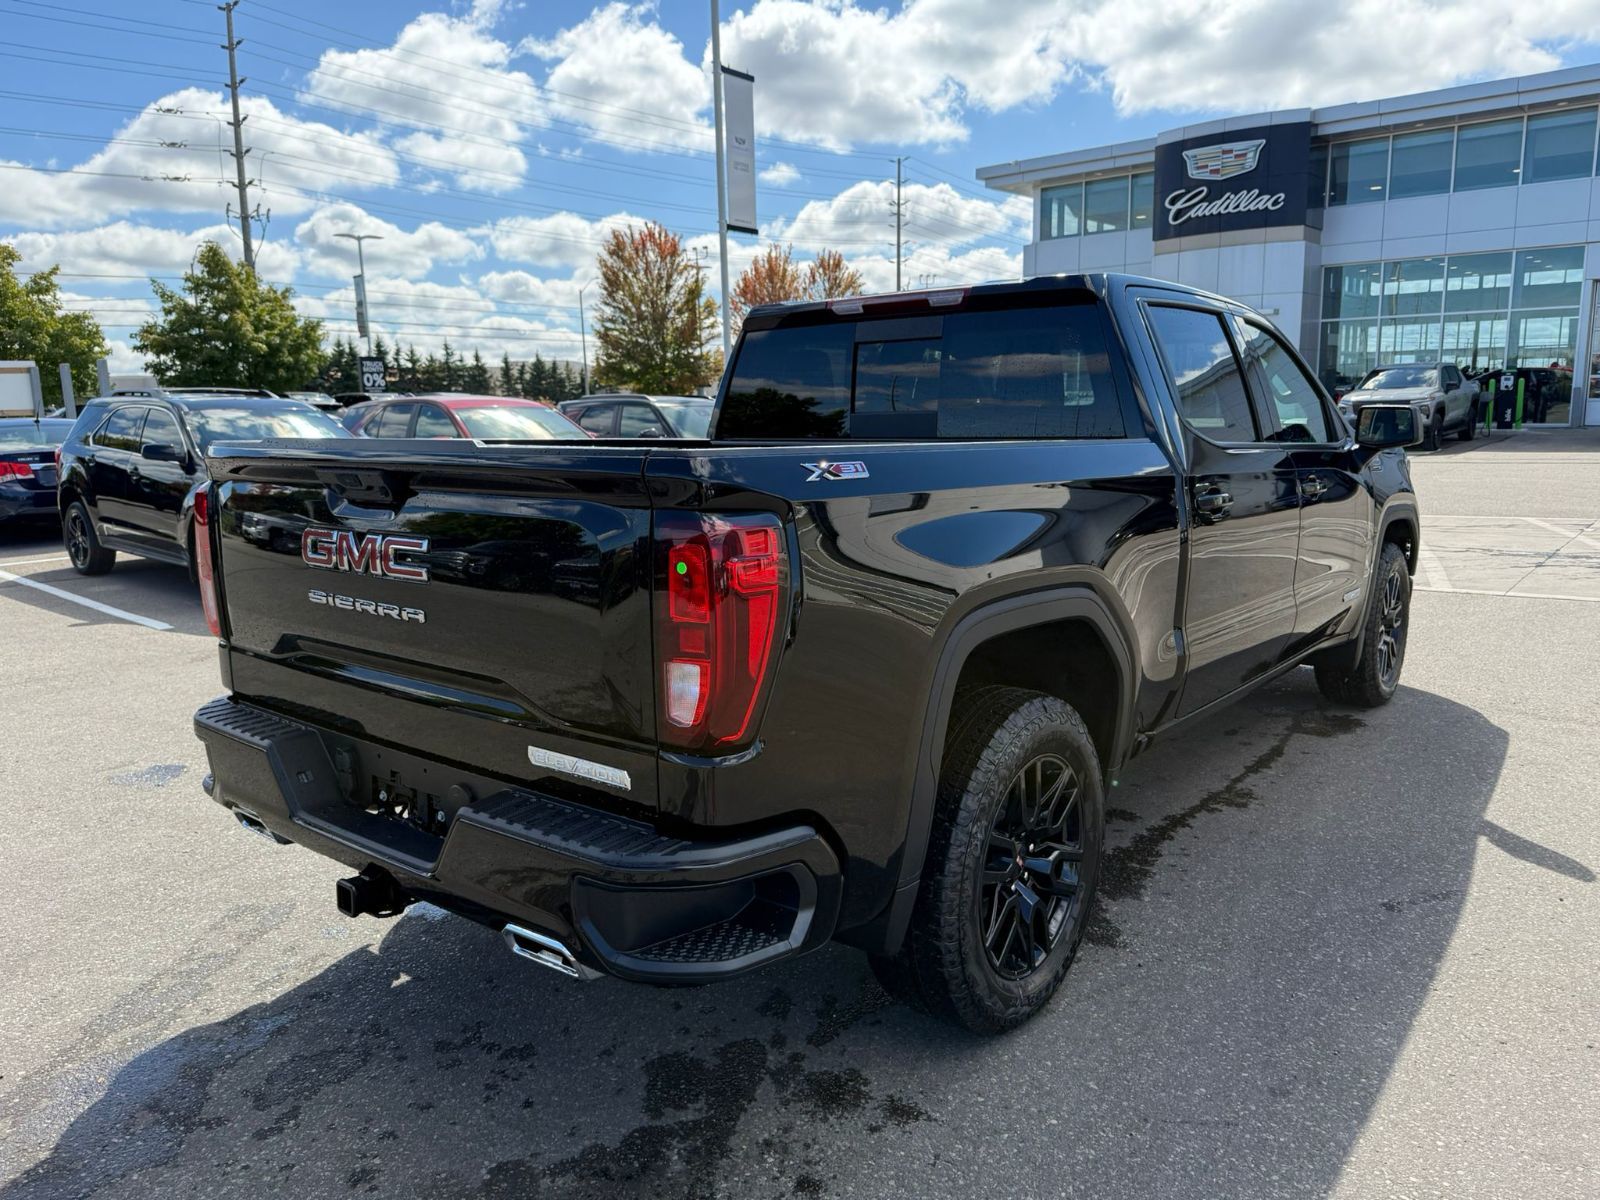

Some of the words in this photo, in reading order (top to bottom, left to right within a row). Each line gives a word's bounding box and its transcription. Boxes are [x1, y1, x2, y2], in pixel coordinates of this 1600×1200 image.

[1165, 186, 1285, 225] Cadillac
[363, 373, 386, 387] 0%
[800, 461, 869, 482] X31
[302, 528, 429, 582] GMC
[308, 589, 426, 624] SIERRA
[533, 750, 624, 785] ELEVATION
